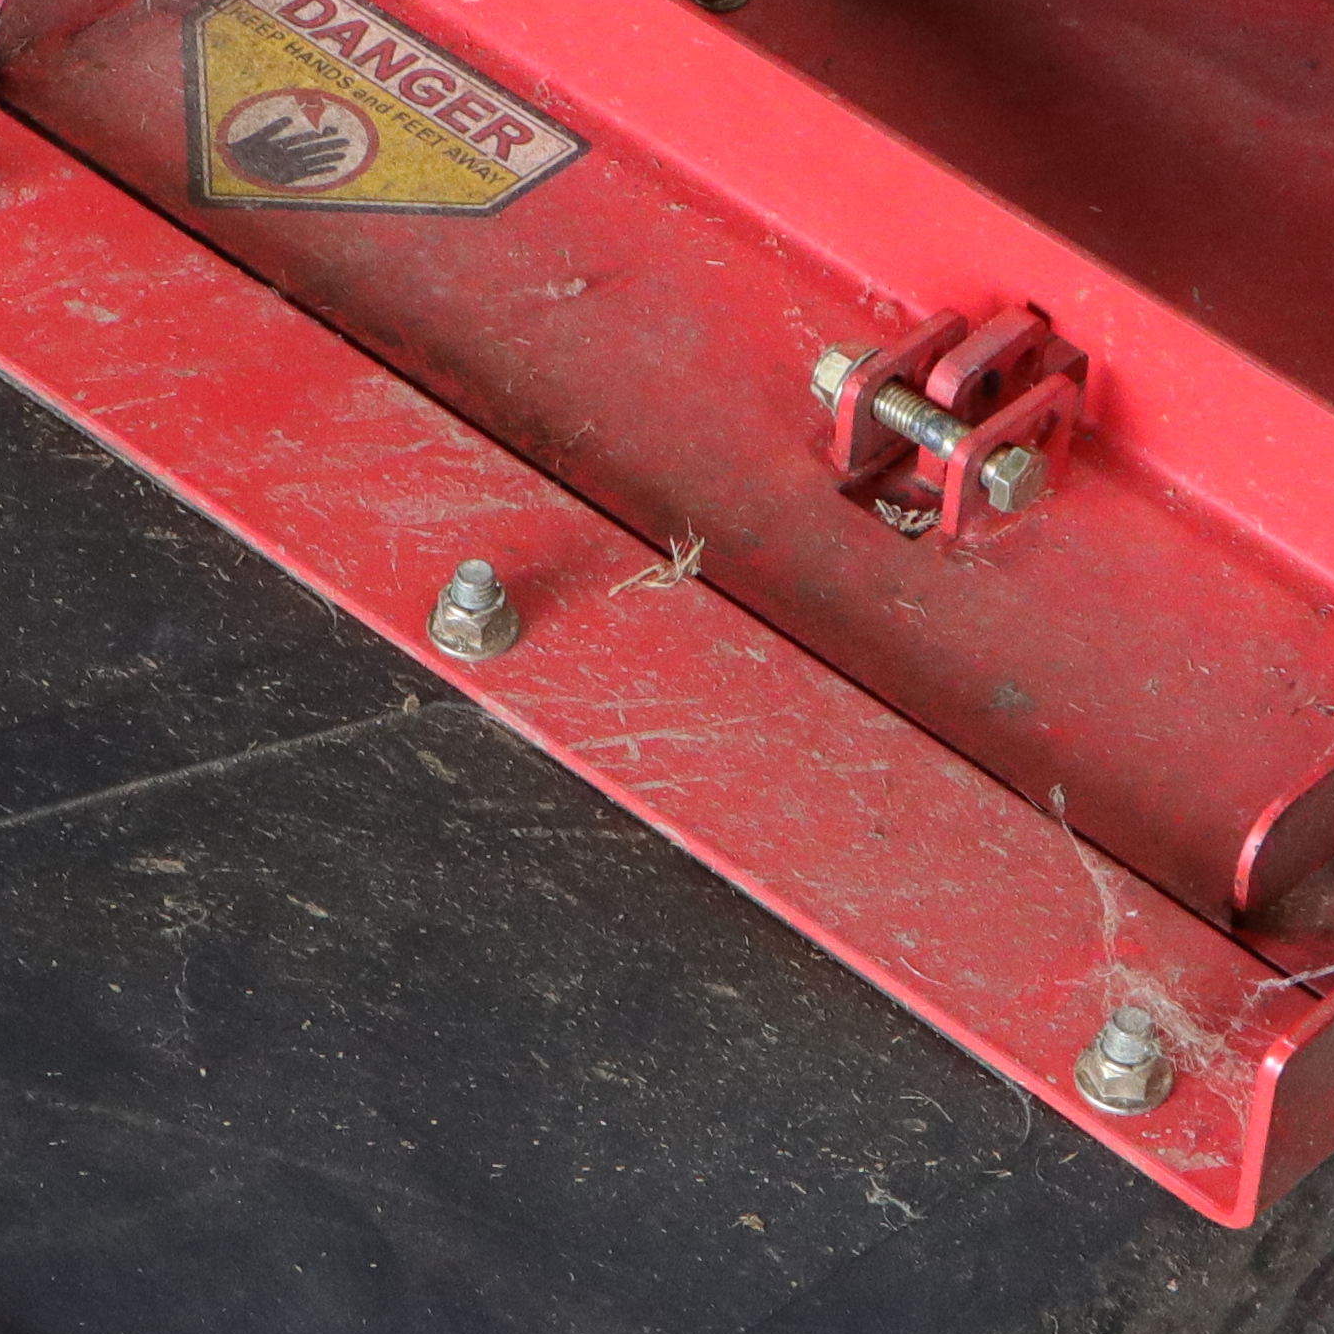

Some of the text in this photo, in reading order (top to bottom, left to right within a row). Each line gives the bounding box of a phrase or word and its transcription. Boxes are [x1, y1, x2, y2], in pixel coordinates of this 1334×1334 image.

[229, 5, 510, 185] KEEP HANDS and FEET AWAY
